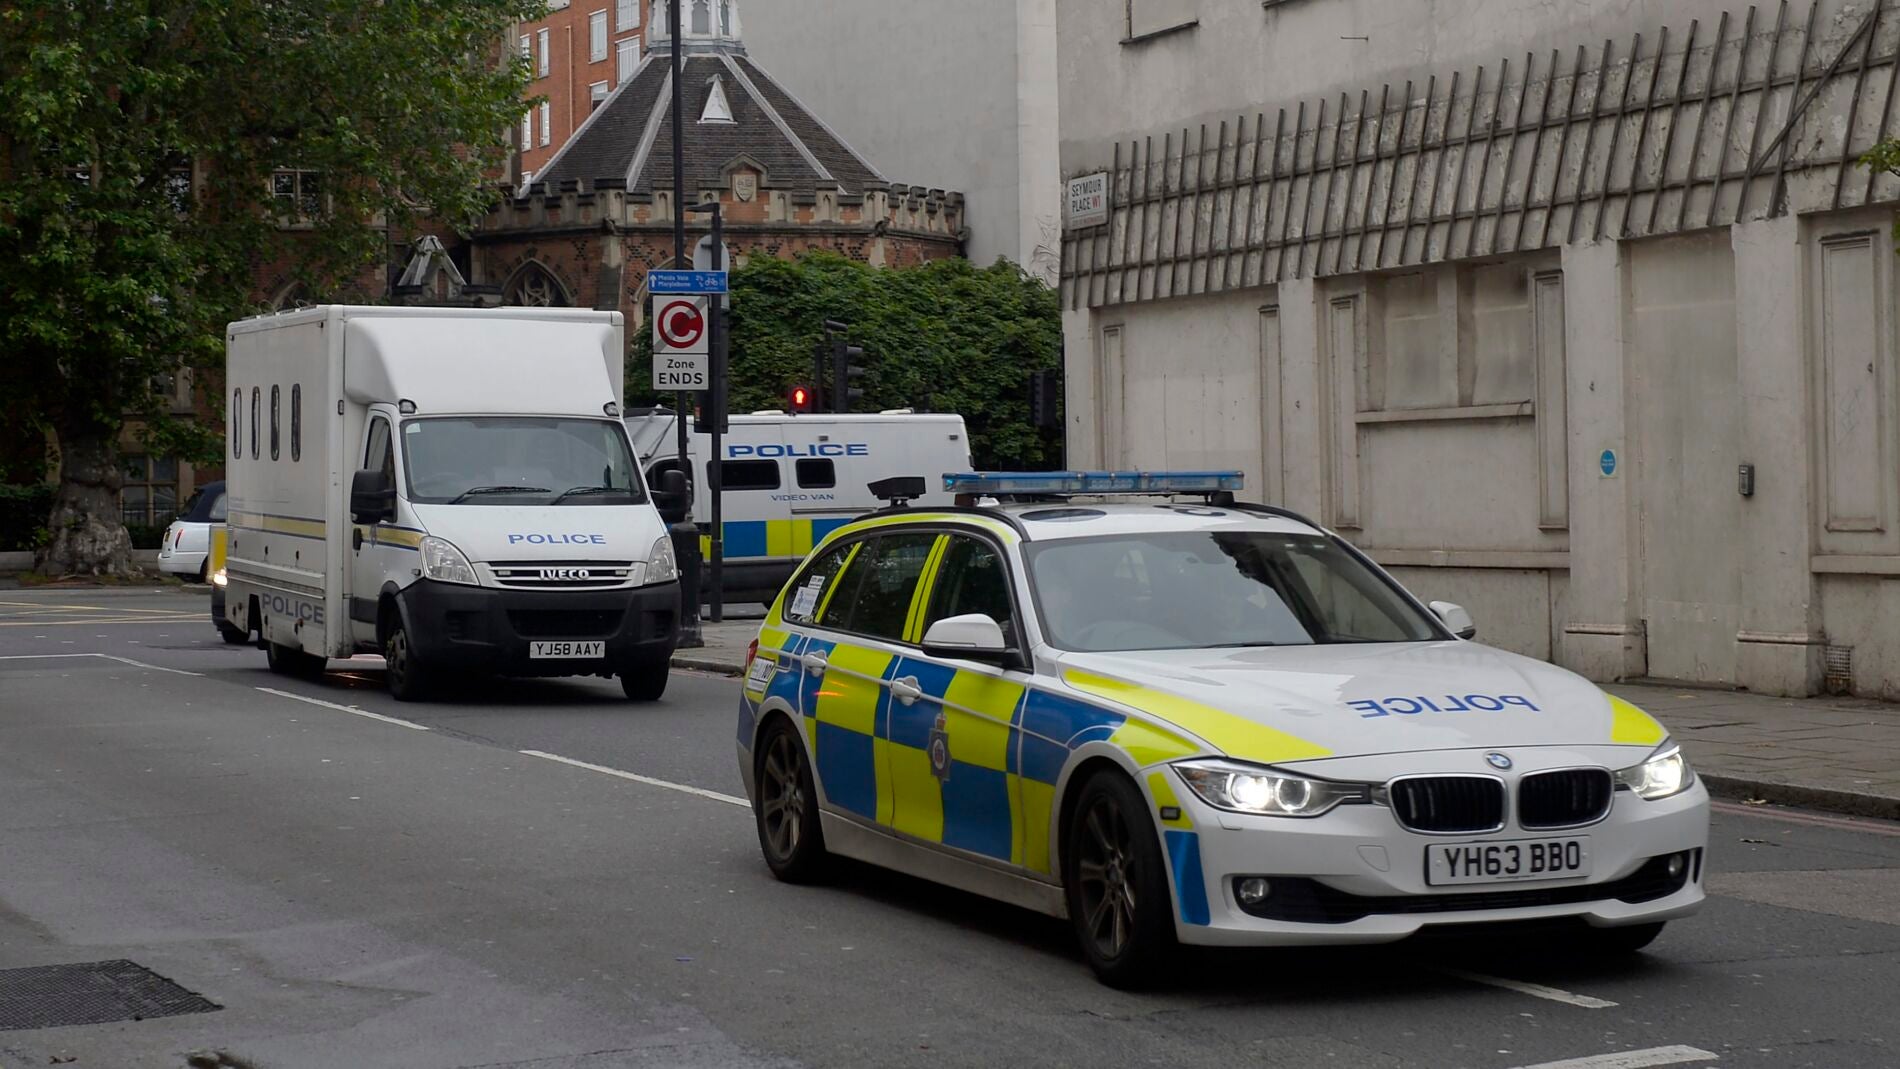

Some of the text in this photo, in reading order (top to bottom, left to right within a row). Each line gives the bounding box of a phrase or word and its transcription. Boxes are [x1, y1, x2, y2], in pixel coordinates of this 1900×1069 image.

[1072, 179, 1101, 197] SEYMOUR
[1072, 195, 1101, 212] PLACE W1
[667, 359, 695, 369] Zone
[658, 372, 703, 385] ENDS
[728, 444, 869, 458] POLICE
[508, 533, 606, 545] POLICE
[539, 568, 590, 580] IVECO
[262, 592, 324, 624] POLICE
[536, 643, 600, 655] YJ58 AAY
[1444, 841, 1580, 877] YH63 BBO
